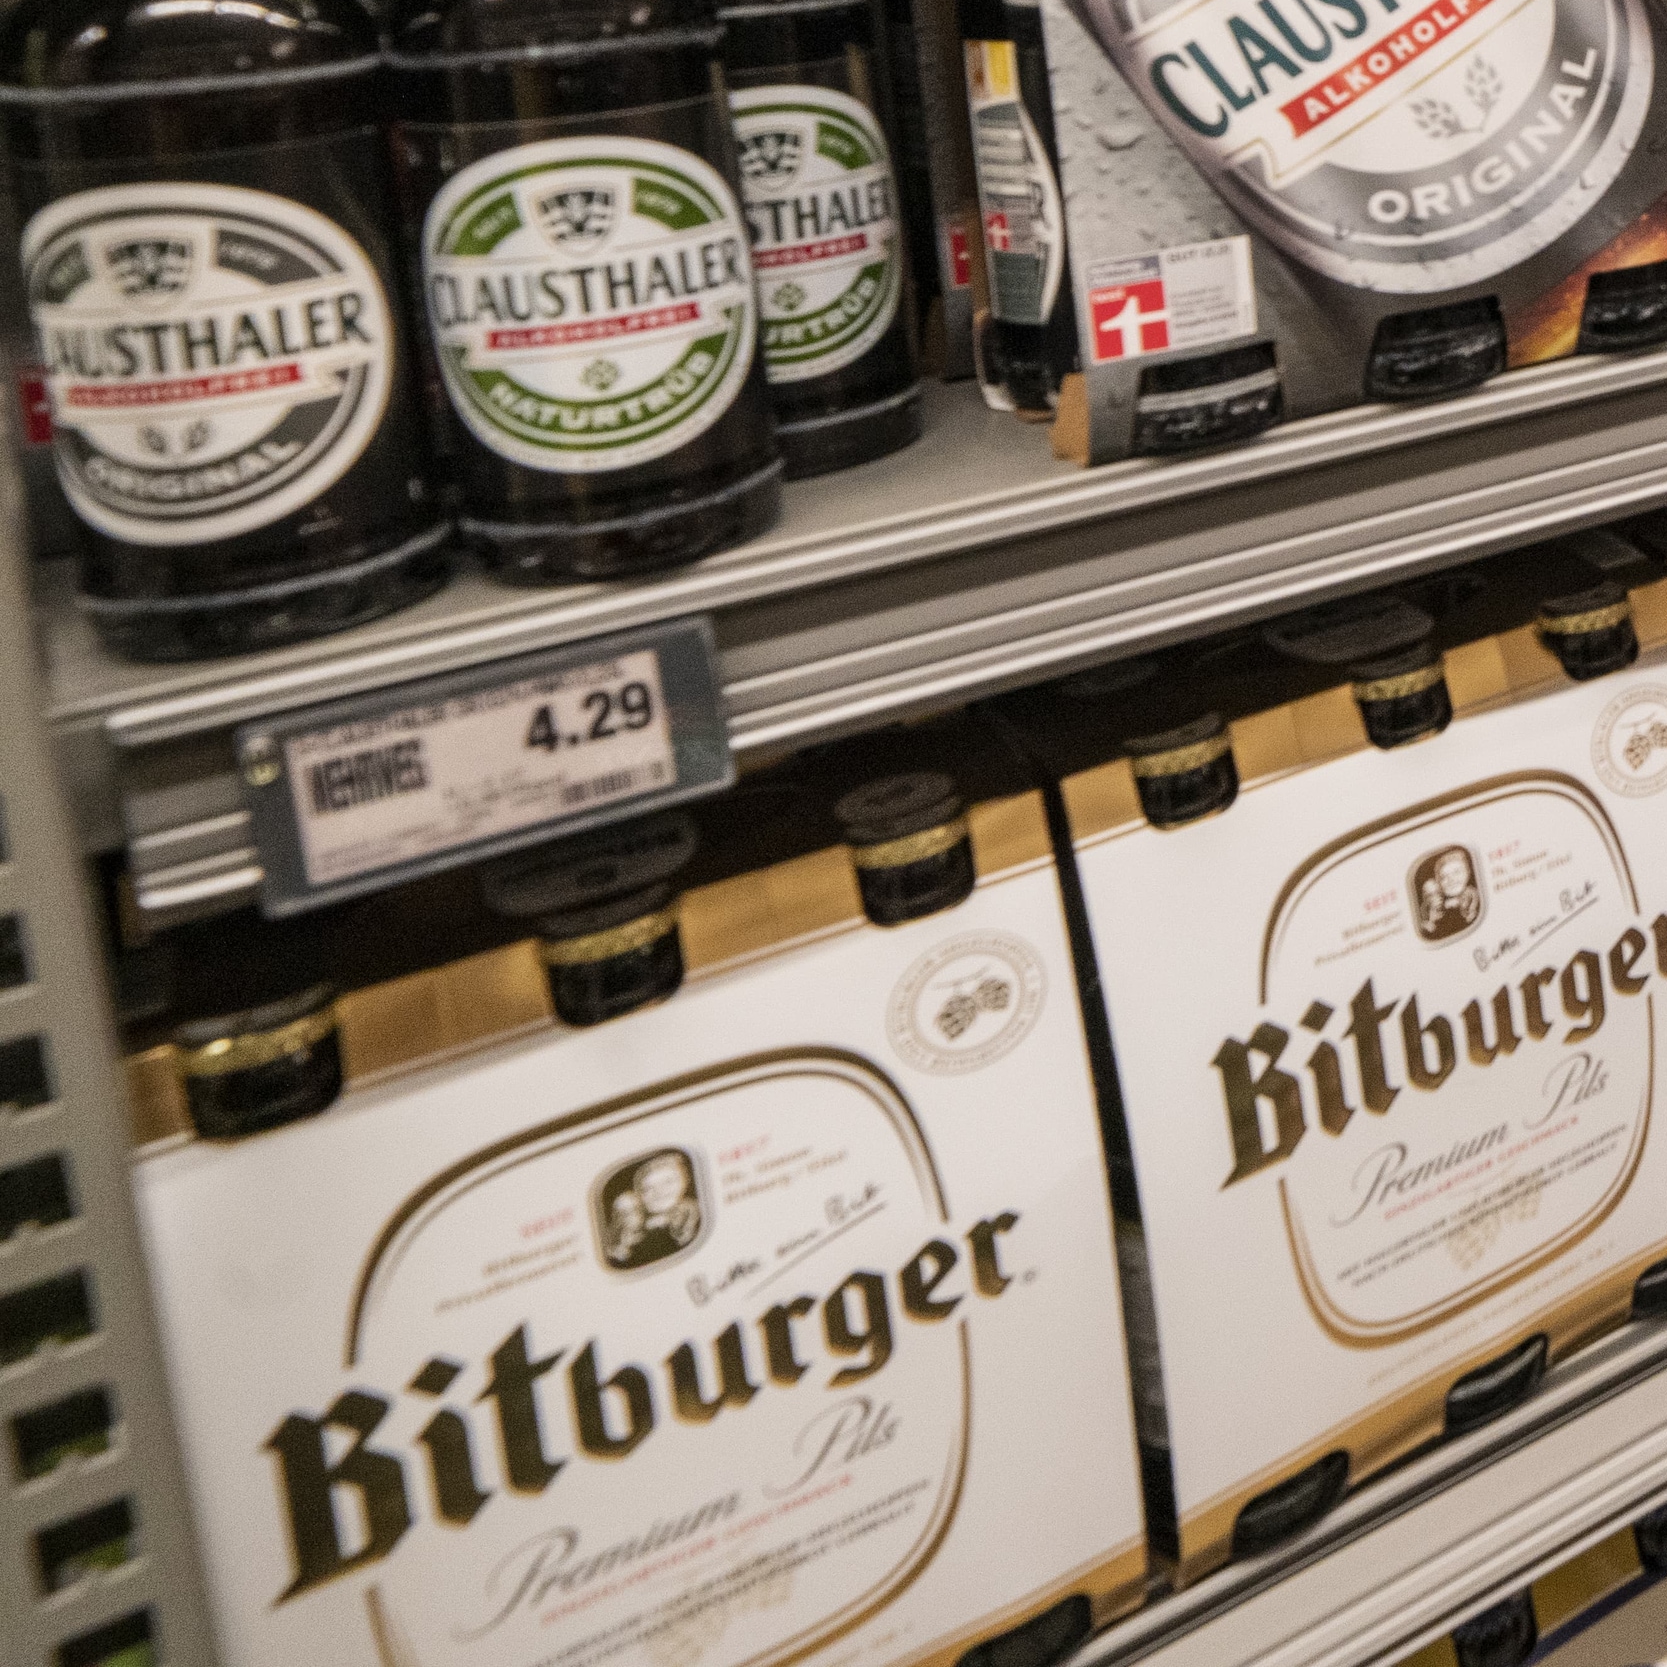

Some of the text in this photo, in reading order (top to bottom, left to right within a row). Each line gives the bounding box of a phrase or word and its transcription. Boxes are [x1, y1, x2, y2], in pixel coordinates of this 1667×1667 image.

[1367, 43, 1600, 225] ORIGINAL
[431, 235, 745, 326] CLAUSTHALER
[489, 345, 716, 435] NATURTRÜB
[525, 681, 653, 754] 4.29
[1330, 1049, 1610, 1229] Premium Pils
[261, 1206, 1023, 1608] Bitburger
[450, 1488, 743, 1645] Premium
[760, 1392, 904, 1502] Pils
